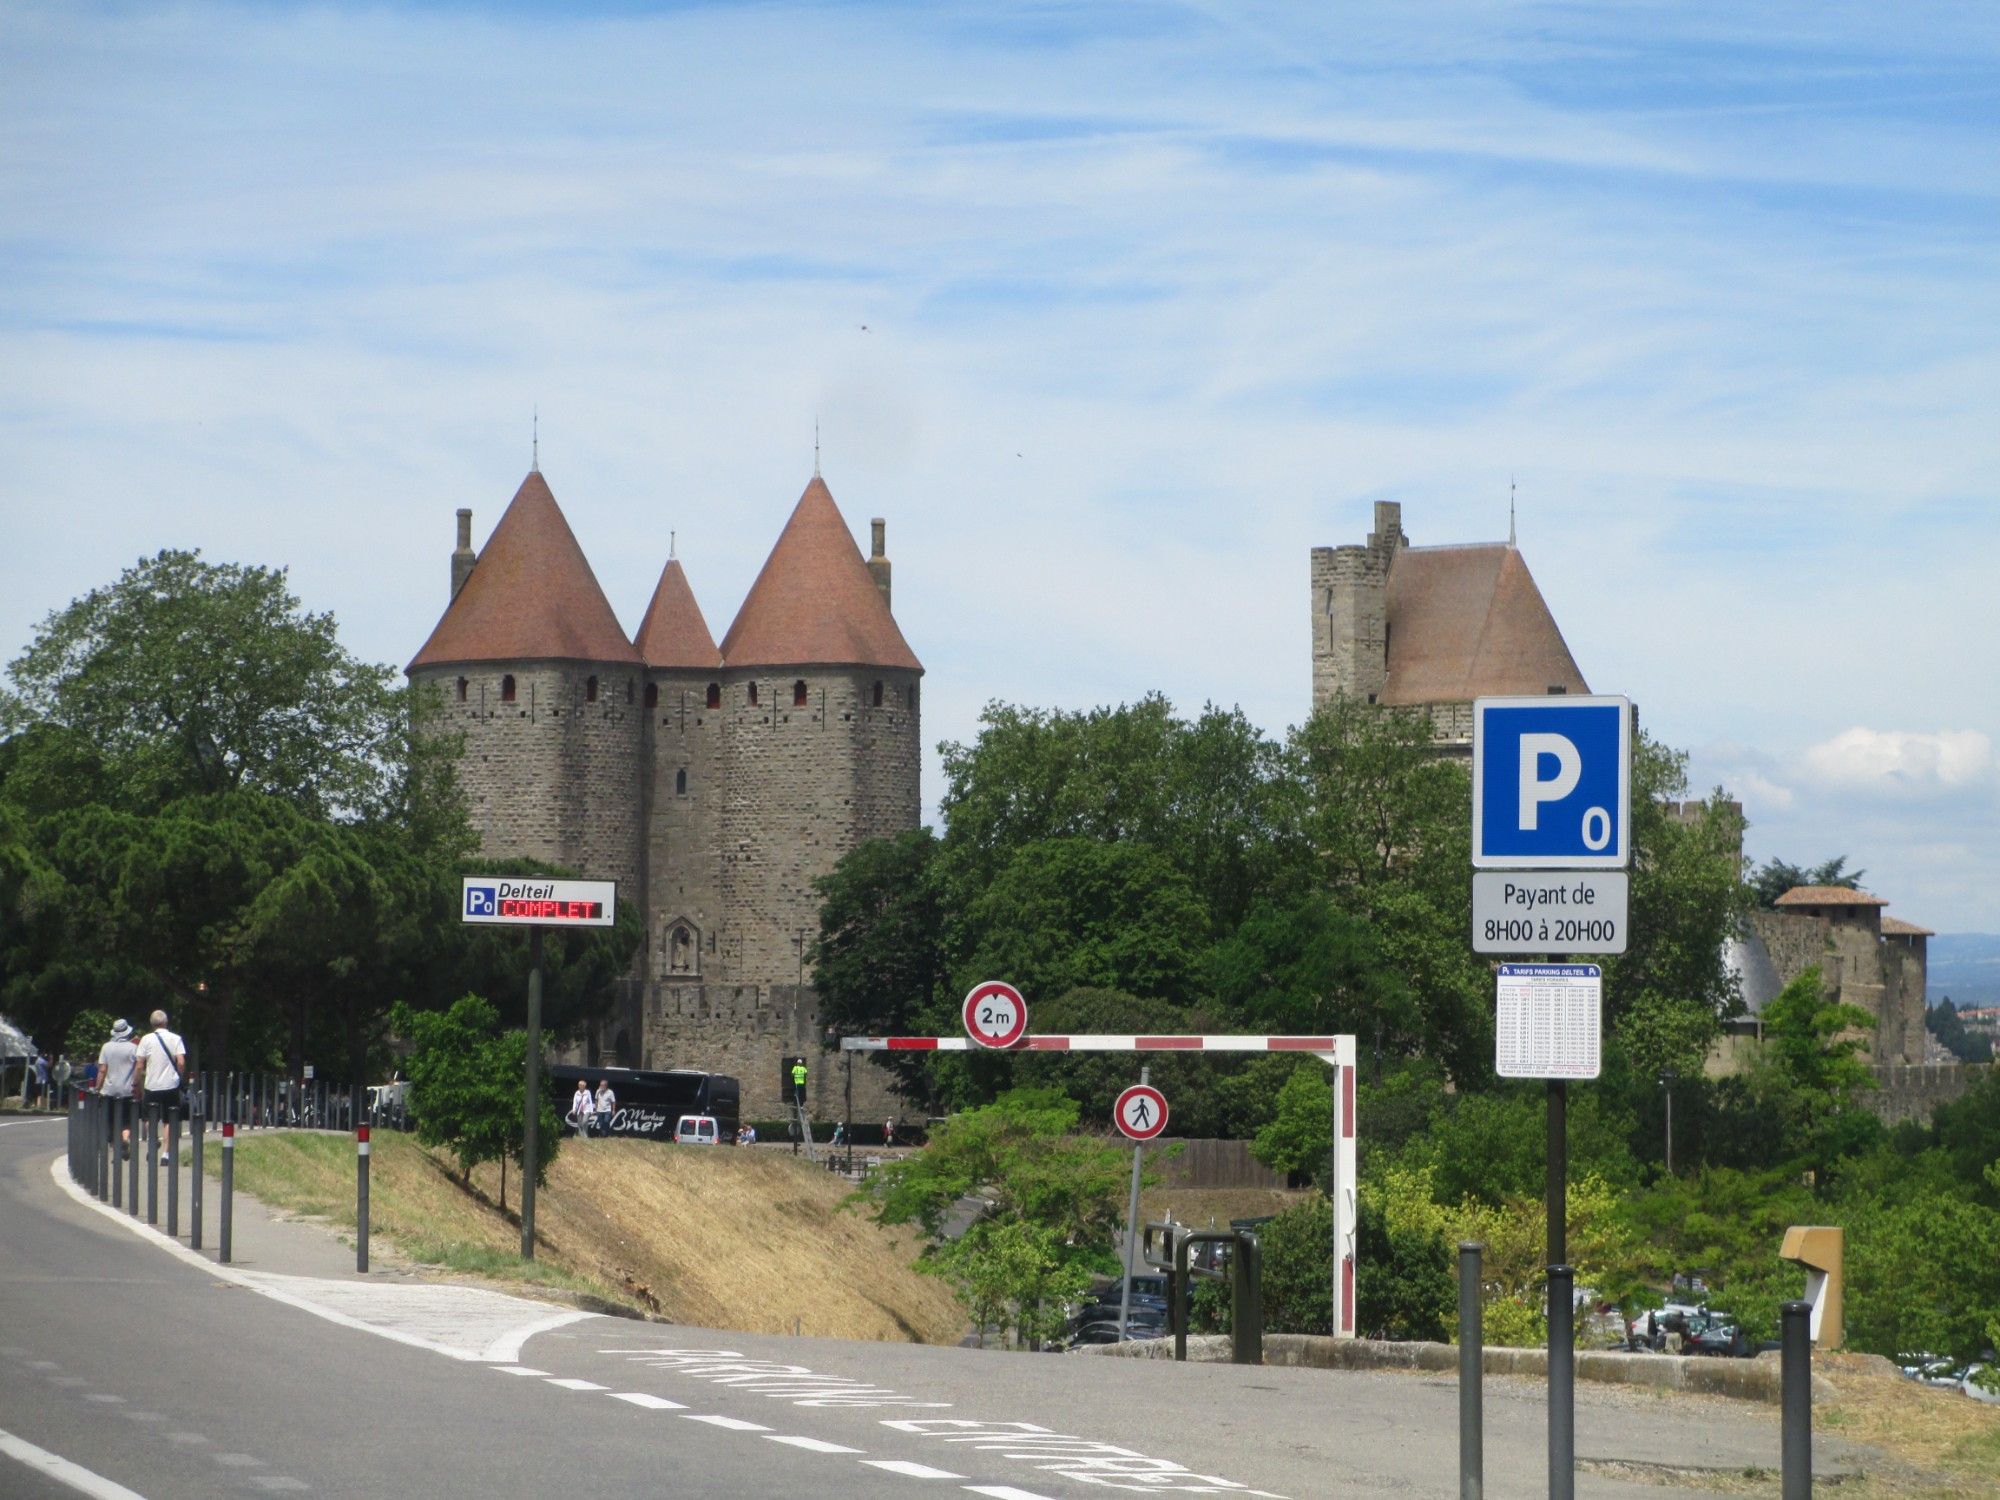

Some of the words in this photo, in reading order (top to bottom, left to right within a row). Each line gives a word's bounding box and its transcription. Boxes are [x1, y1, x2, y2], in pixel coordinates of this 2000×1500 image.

[498, 882, 554, 899] Delteil
[1504, 883, 1566, 910] Payant
[1571, 881, 1595, 905] de
[502, 900, 595, 919] COMPLET
[1485, 919, 1533, 941] 8H00
[1538, 918, 1549, 941] à
[1554, 919, 1615, 942] 20H00
[1534, 968, 1560, 976] PARKING
[598, 1349, 953, 1407] PARKING
[879, 1420, 1291, 1499] ENTREE
